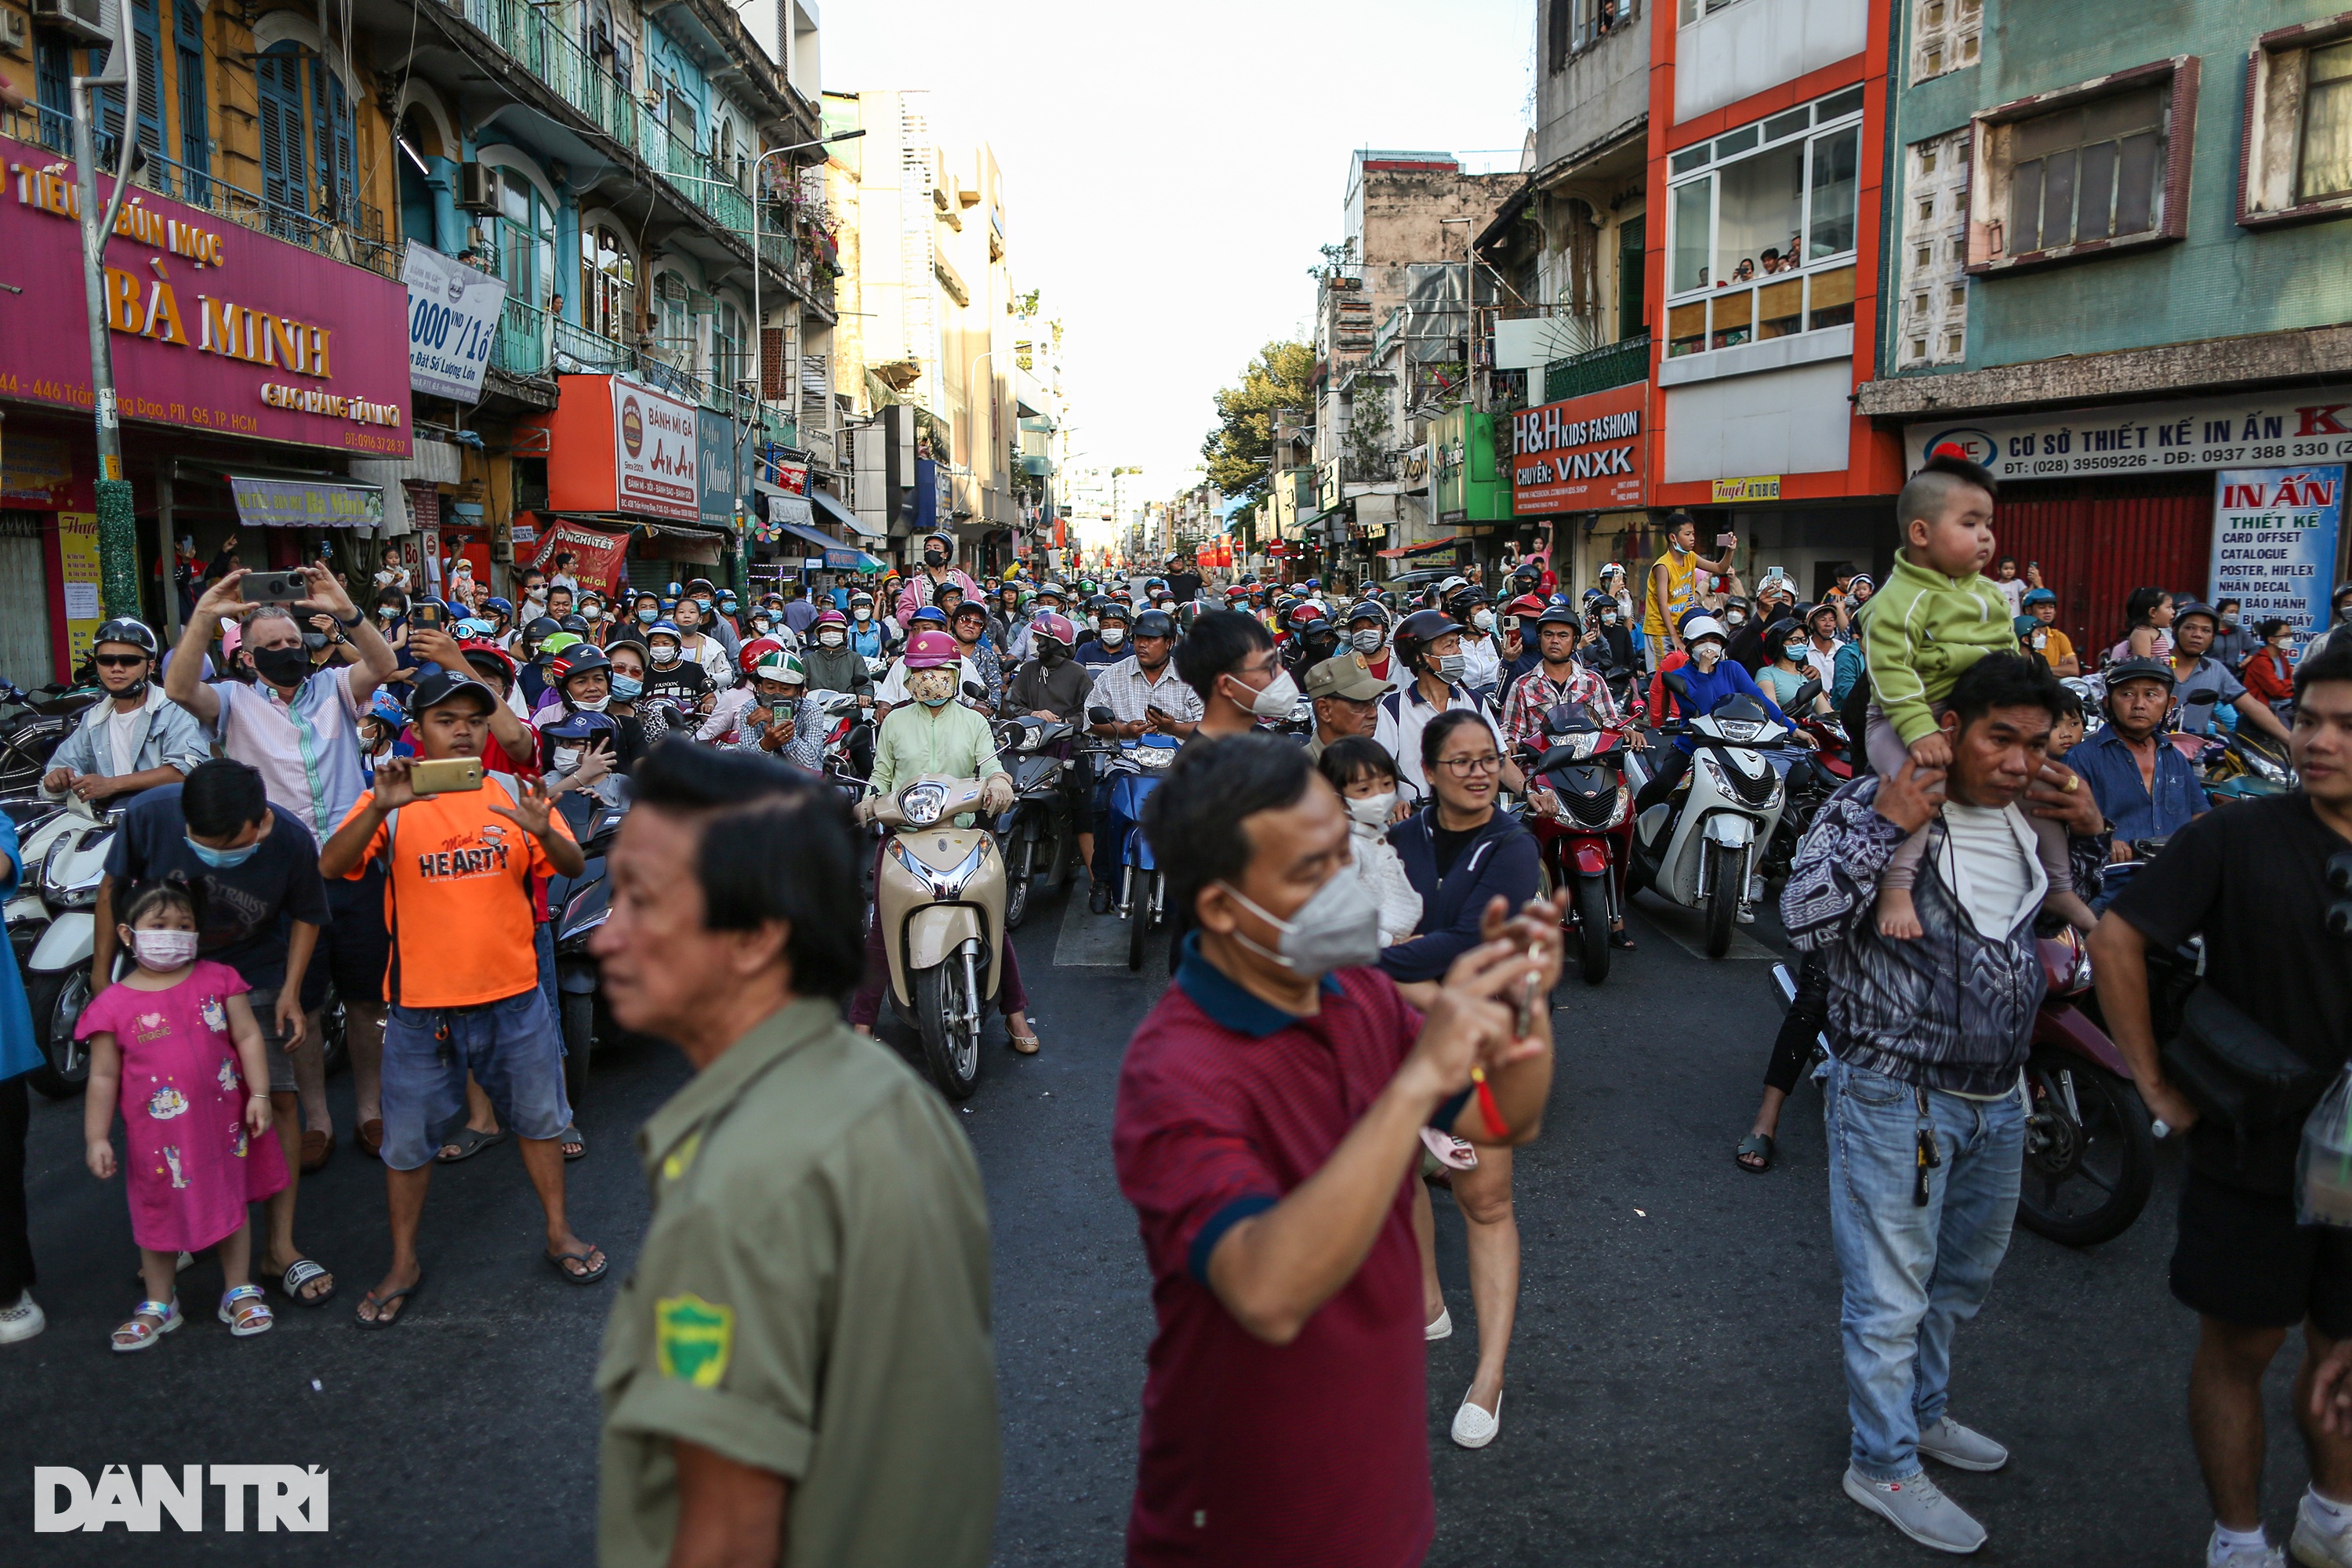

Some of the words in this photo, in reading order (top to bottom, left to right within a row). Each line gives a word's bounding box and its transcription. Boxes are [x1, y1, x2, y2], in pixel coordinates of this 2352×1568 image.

[168, 219, 224, 269] MỌC
[103, 257, 190, 346] BÀ
[198, 295, 333, 379] MINH
[416, 351, 429, 371] Đặt
[430, 356, 442, 371] Số
[441, 362, 462, 381] Lượng
[463, 366, 476, 381] Lớn
[33, 379, 61, 401] 446
[64, 382, 95, 405] Trần
[136, 397, 165, 420] Đạo,
[169, 405, 187, 424] P11,
[191, 407, 212, 428] Q5,
[231, 415, 257, 433] HCM
[261, 383, 305, 412] GIAO
[304, 387, 349, 419] HÀNG
[348, 395, 377, 426] TẬN
[648, 405, 670, 431] BÁNH
[673, 412, 681, 434] MÌ
[682, 416, 692, 438] GÀ
[1513, 408, 1563, 455] H&H
[1562, 420, 1588, 448] KIDS
[1589, 411, 1640, 443] FASHION
[2009, 433, 2035, 457] CƠ
[2044, 427, 2071, 455] SỞ
[2082, 421, 2149, 452] THIẾT
[2158, 416, 2194, 447] KẾ
[2204, 419, 2230, 444] IN
[2241, 410, 2282, 441] ẤN
[376, 437, 387, 451] 37
[387, 438, 396, 452] 28
[397, 440, 405, 453] 37
[650, 438, 672, 476] An
[673, 445, 694, 481] An
[2004, 462, 2028, 474] ĐT:
[2033, 459, 2069, 475] (028)
[2074, 454, 2147, 471] 39509226
[2164, 450, 2196, 466] DĐ:
[2202, 447, 2245, 463] 0937
[2251, 445, 2286, 459] 388
[2292, 441, 2329, 457] 330
[1516, 461, 1554, 487] CHUYÊN:
[1555, 445, 1634, 481] VNXK
[304, 490, 326, 514] Bà
[328, 492, 365, 515] Minh
[2220, 482, 2267, 510] IN
[2268, 473, 2336, 510] ẤN
[2230, 512, 2286, 529] THIẾT
[2293, 510, 2323, 528] KẾ
[405, 542, 418, 564] Bò
[2223, 532, 2252, 543] CARD
[2257, 532, 2302, 543] OFFSET
[2221, 549, 2288, 560] CATALOGUE
[594, 577, 608, 587] GÀ
[2219, 578, 2250, 592] NHÃN
[2254, 581, 2291, 592] DECAL
[2220, 565, 2267, 578] POSTER,
[2271, 565, 2314, 576] HIFLEX
[2245, 593, 2270, 608] BẢO
[2273, 595, 2307, 609] HÀNH
[2285, 612, 2314, 626] GIẤY
[419, 844, 511, 878] HEARTY
